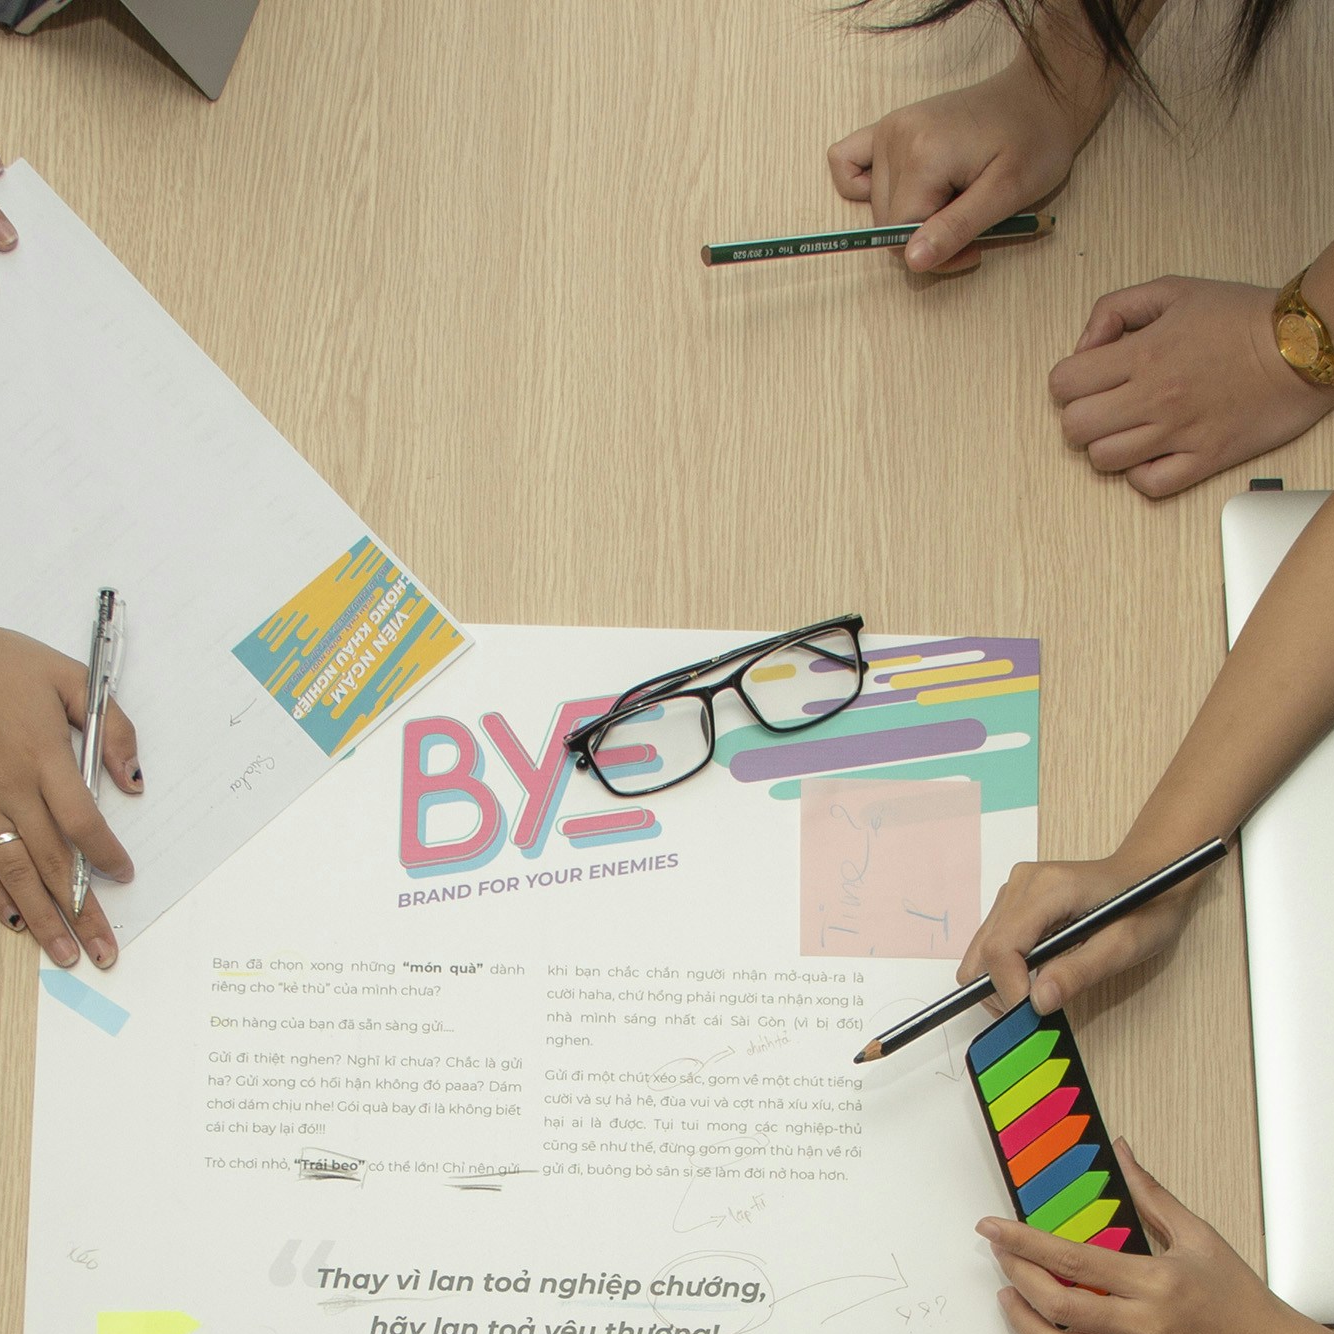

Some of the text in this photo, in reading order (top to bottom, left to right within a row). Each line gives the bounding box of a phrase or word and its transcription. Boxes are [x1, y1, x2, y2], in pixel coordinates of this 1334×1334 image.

[777, 245, 793, 254] Trio
[799, 240, 838, 252] STABILO
[330, 610, 411, 705] VIÊN NGẬM
[292, 664, 339, 720] NGHIỆP
[399, 690, 663, 880] BYE
[397, 852, 678, 908] BRAND FOR YOUR ENEMIES
[212, 957, 238, 969] Bạn
[245, 958, 262, 969] đã
[269, 959, 303, 970] chọn
[310, 962, 343, 973] xong
[351, 960, 395, 974] những
[489, 963, 524, 974] dành
[547, 964, 864, 984] khi bạn chắc chắn người nhận mở-quà-ra là
[211, 980, 246, 994] riêng
[249, 981, 275, 993] cho
[333, 982, 357, 994] của
[361, 983, 397, 995] mình
[400, 984, 441, 996] chưa?
[546, 987, 863, 1008] cười haha, chứ hổng phải người ta nhận xong là
[209, 1015, 238, 1027] Đơn
[242, 1016, 277, 1031] hàng
[280, 1016, 304, 1028] của
[308, 1018, 334, 1031] bạn
[337, 1018, 354, 1030] đã
[384, 1019, 417, 1034] sàng
[546, 1011, 863, 1031] nhà mình sáng nhất cái Sài Gòn (vì bị đốt)
[546, 1034, 593, 1047] nghen.
[208, 1050, 522, 1071] Gửi đi thiệt nghen? Nghĩ kĩ chưa? Chắc là gửi
[207, 1074, 521, 1093] ha? Gửi xong có hối hận không đó paaa? Dám
[206, 1097, 521, 1117] chơi dám chịu nhe! Gói quà bay đi là không biết
[205, 1120, 325, 1136] cái chi bay lại đó!!!
[204, 1156, 226, 1168] Trò
[229, 1157, 257, 1169] chơi
[261, 1157, 290, 1170] nhỏ,
[368, 1161, 385, 1172] có
[388, 1160, 410, 1172] thể
[415, 1161, 439, 1173] lớn!
[442, 1161, 465, 1173] Chỉ
[469, 1163, 495, 1174] nên
[498, 1163, 520, 1177] gửi
[317, 1267, 771, 1307] Thay vì lan toả nghiệp chướng,
